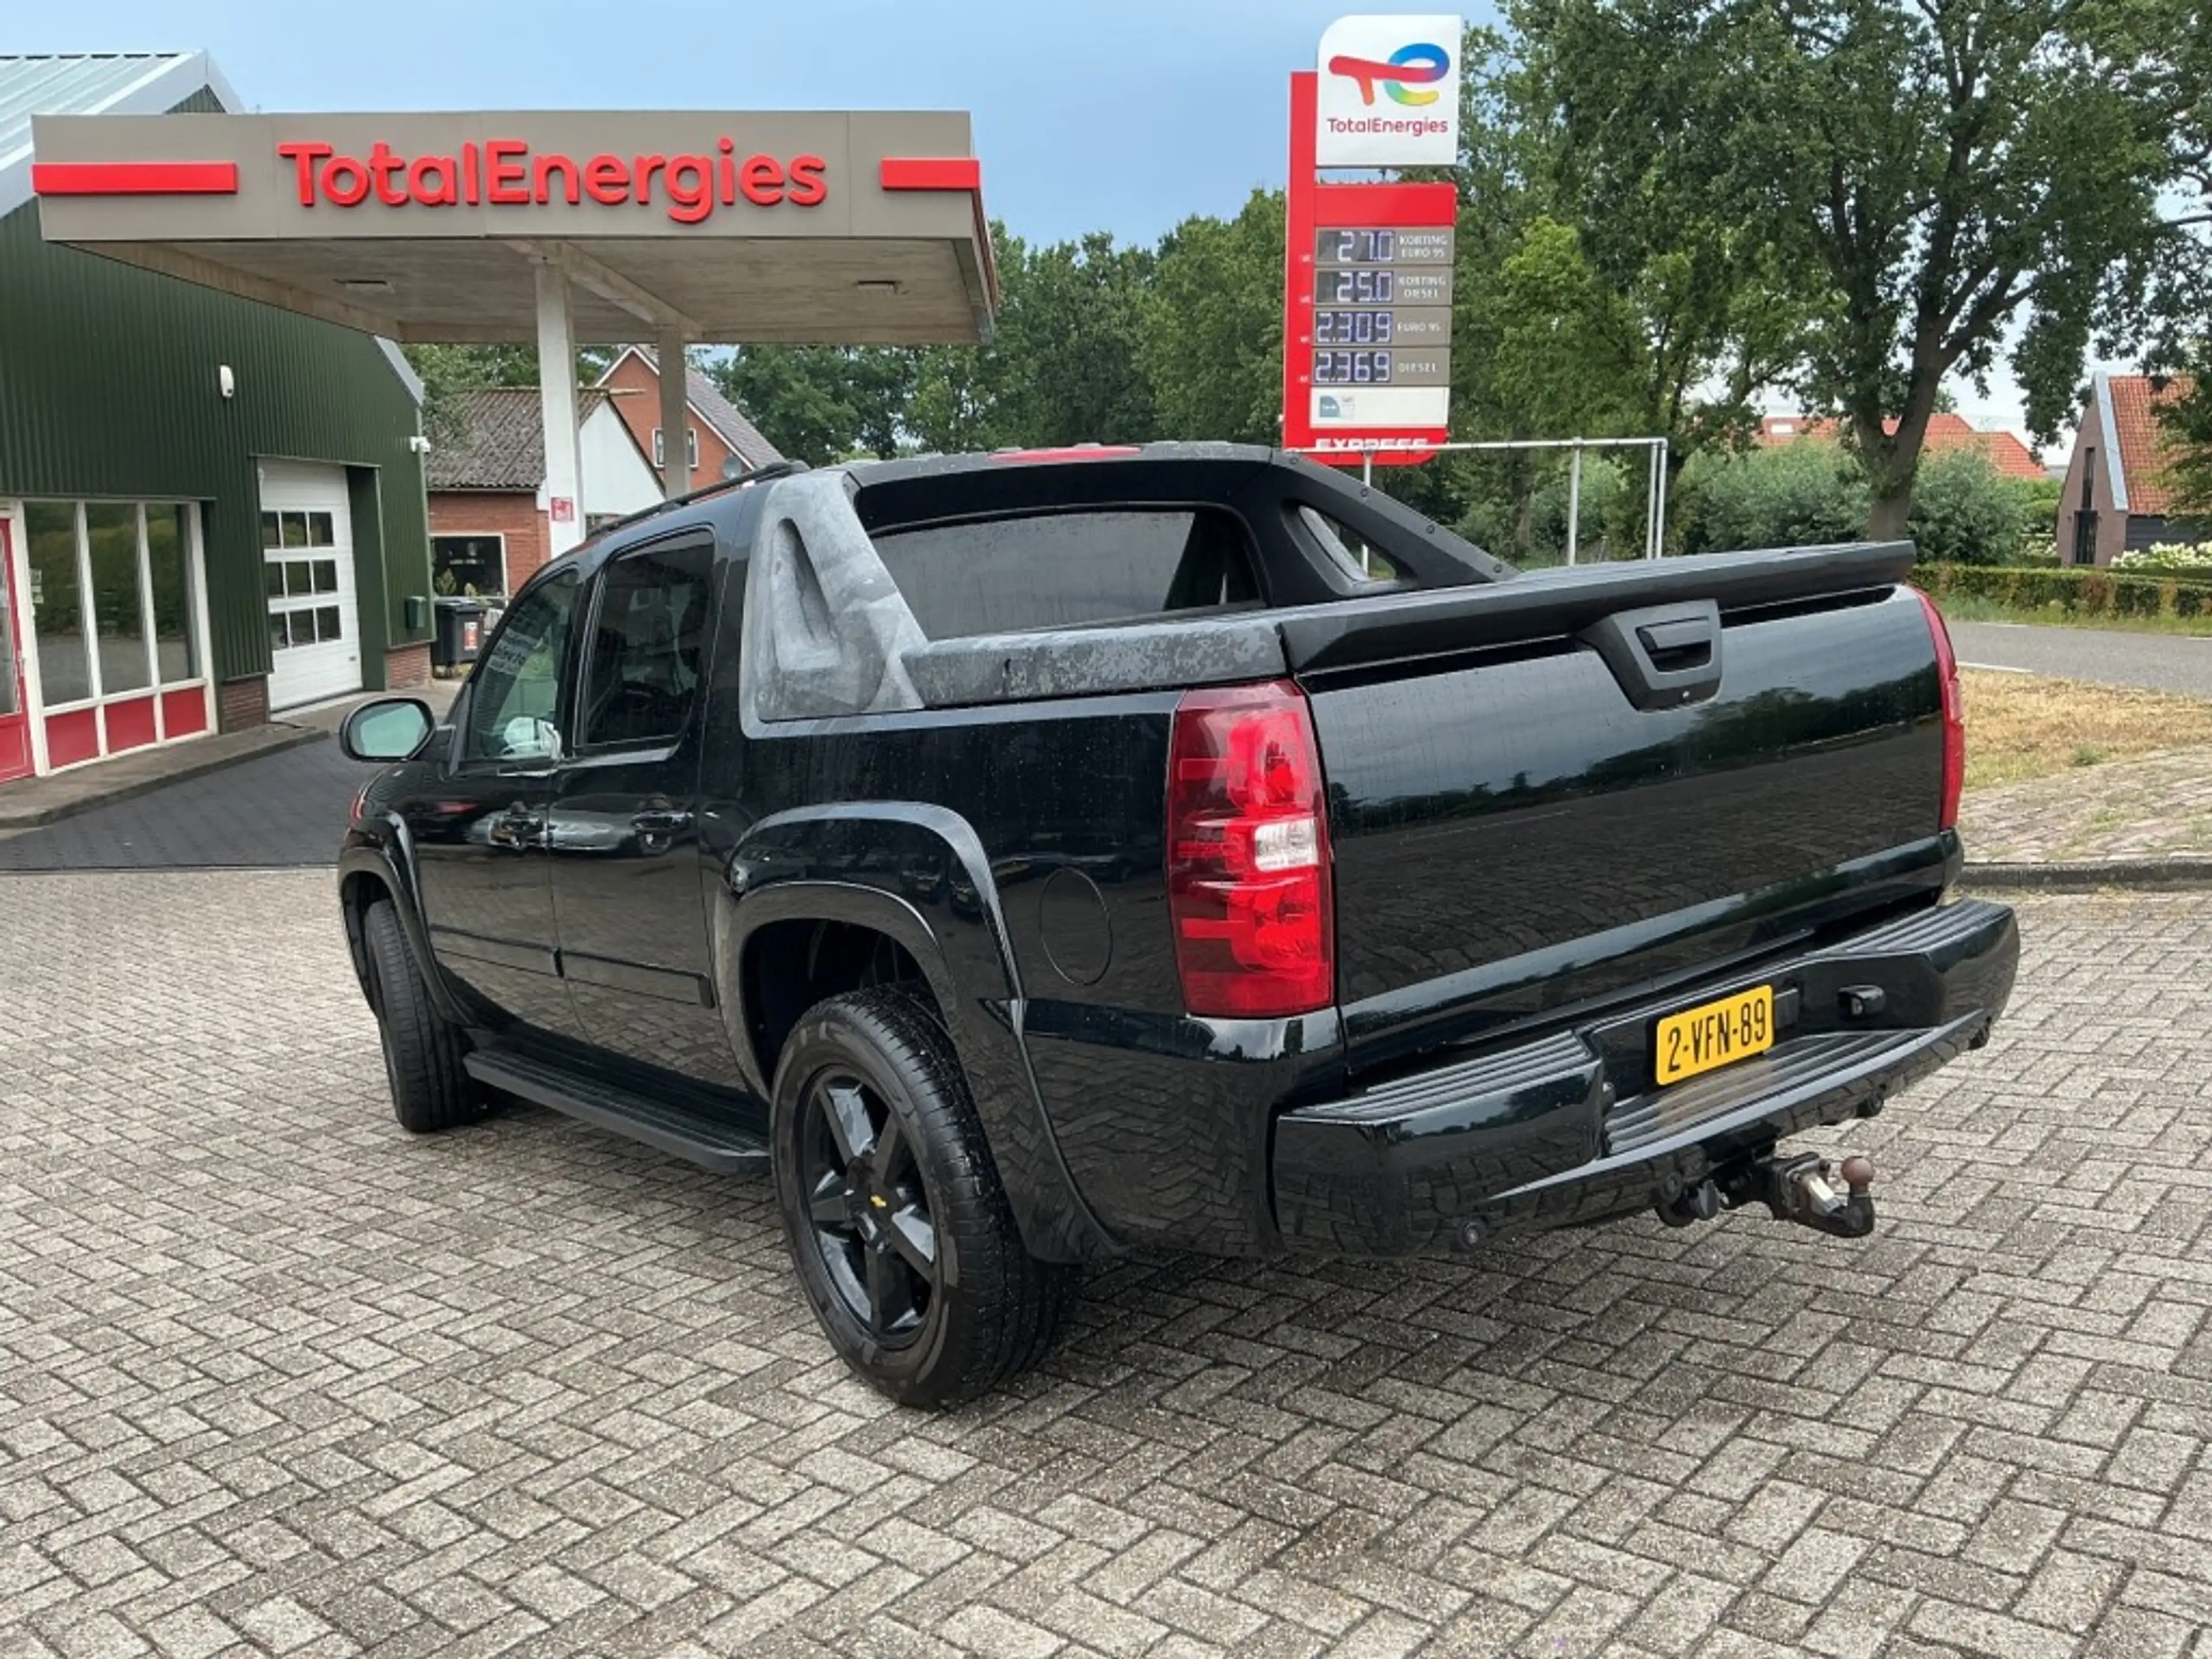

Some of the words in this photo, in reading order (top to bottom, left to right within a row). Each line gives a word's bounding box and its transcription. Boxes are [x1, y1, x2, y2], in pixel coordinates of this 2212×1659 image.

[1327, 117, 1449, 137] TotalEnergies
[278, 137, 827, 224] TotalEnergies
[1399, 234, 1448, 246] KORTING
[1402, 248, 1430, 259] EURO
[1432, 247, 1445, 258] 95
[1397, 275, 1446, 286] KORTING
[1403, 288, 1440, 299] DIESEL
[1397, 321, 1427, 332] EURO
[1397, 362, 1437, 373] DIESEL
[1668, 998, 1766, 1073] 2-VFN-89
